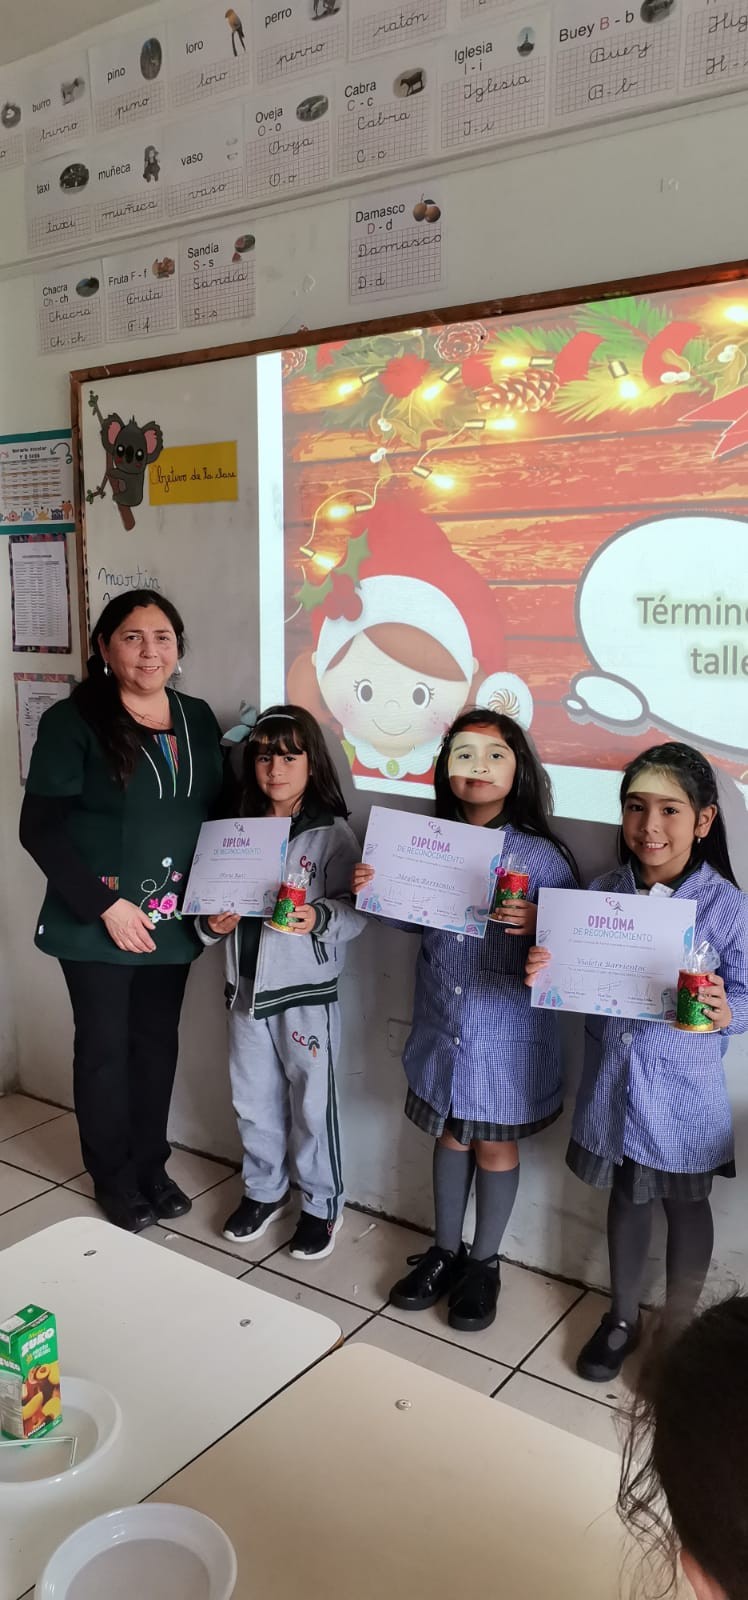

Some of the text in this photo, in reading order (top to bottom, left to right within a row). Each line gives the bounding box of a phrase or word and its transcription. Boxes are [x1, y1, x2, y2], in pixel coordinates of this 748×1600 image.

[264, 7, 292, 28] perro
[373, 10, 429, 37] ratón
[559, 23, 596, 42] Buey
[600, 16, 610, 31] B
[625, 10, 634, 24] b
[185, 40, 204, 54] loro
[455, 41, 493, 64] Iglesia
[589, 42, 652, 64] Buey
[276, 42, 325, 70] perro
[107, 66, 126, 83] pino
[197, 71, 228, 88] loro
[344, 80, 376, 98] Cabra
[464, 75, 530, 103] Iglesia
[32, 99, 51, 112] burro
[115, 97, 150, 120] pino
[256, 107, 283, 124] Oveja
[358, 112, 411, 131] Cabra
[40, 122, 79, 140] burro
[269, 138, 313, 156] Oveja
[180, 151, 204, 167] vaso
[98, 163, 131, 180] muñeca
[36, 182, 50, 195] taxi
[188, 183, 228, 198] vaso
[102, 201, 158, 220] muñeca
[355, 204, 406, 222] Damasco
[45, 217, 76, 234] taxi
[368, 223, 376, 234] D
[386, 219, 393, 231] d
[187, 243, 219, 259] Sandía
[358, 234, 442, 258] Damasco
[108, 273, 129, 286] Fruta
[193, 272, 248, 290] Sandía
[42, 284, 68, 296] Chacra
[127, 291, 162, 305] Fruta
[48, 309, 91, 322] Chacra
[190, 466, 202, 480] de
[203, 467, 214, 480] la
[215, 468, 237, 480] clase
[636, 594, 748, 626] Términ
[222, 837, 251, 848] DIPLOMA
[411, 836, 450, 853] DIPLOMA
[407, 847, 465, 864] RECONOCIMIENTO
[588, 915, 635, 932] DIPLOMA
[573, 927, 653, 942] DE RECONOCIMIENTO
